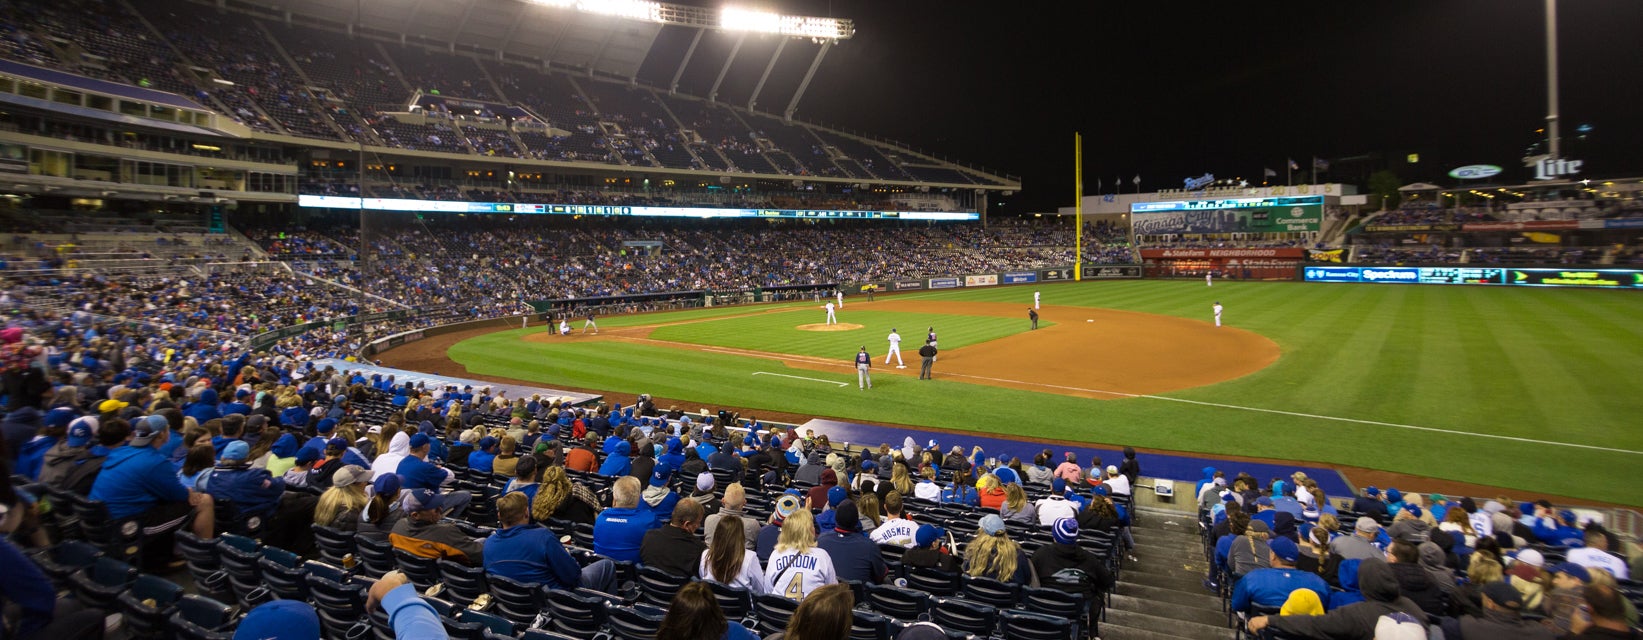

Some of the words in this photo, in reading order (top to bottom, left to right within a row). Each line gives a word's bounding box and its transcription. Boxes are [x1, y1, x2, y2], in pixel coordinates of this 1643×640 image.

[1534, 158, 1583, 180] Lite
[1134, 215, 1184, 233] Kansas
[1276, 217, 1319, 225] Commerce
[1209, 249, 1276, 257] NEIGHBORHOOD
[1363, 269, 1417, 280] Spectrum
[881, 526, 911, 541] HOSMER
[776, 554, 817, 571] GORDON
[784, 571, 805, 602] 4
